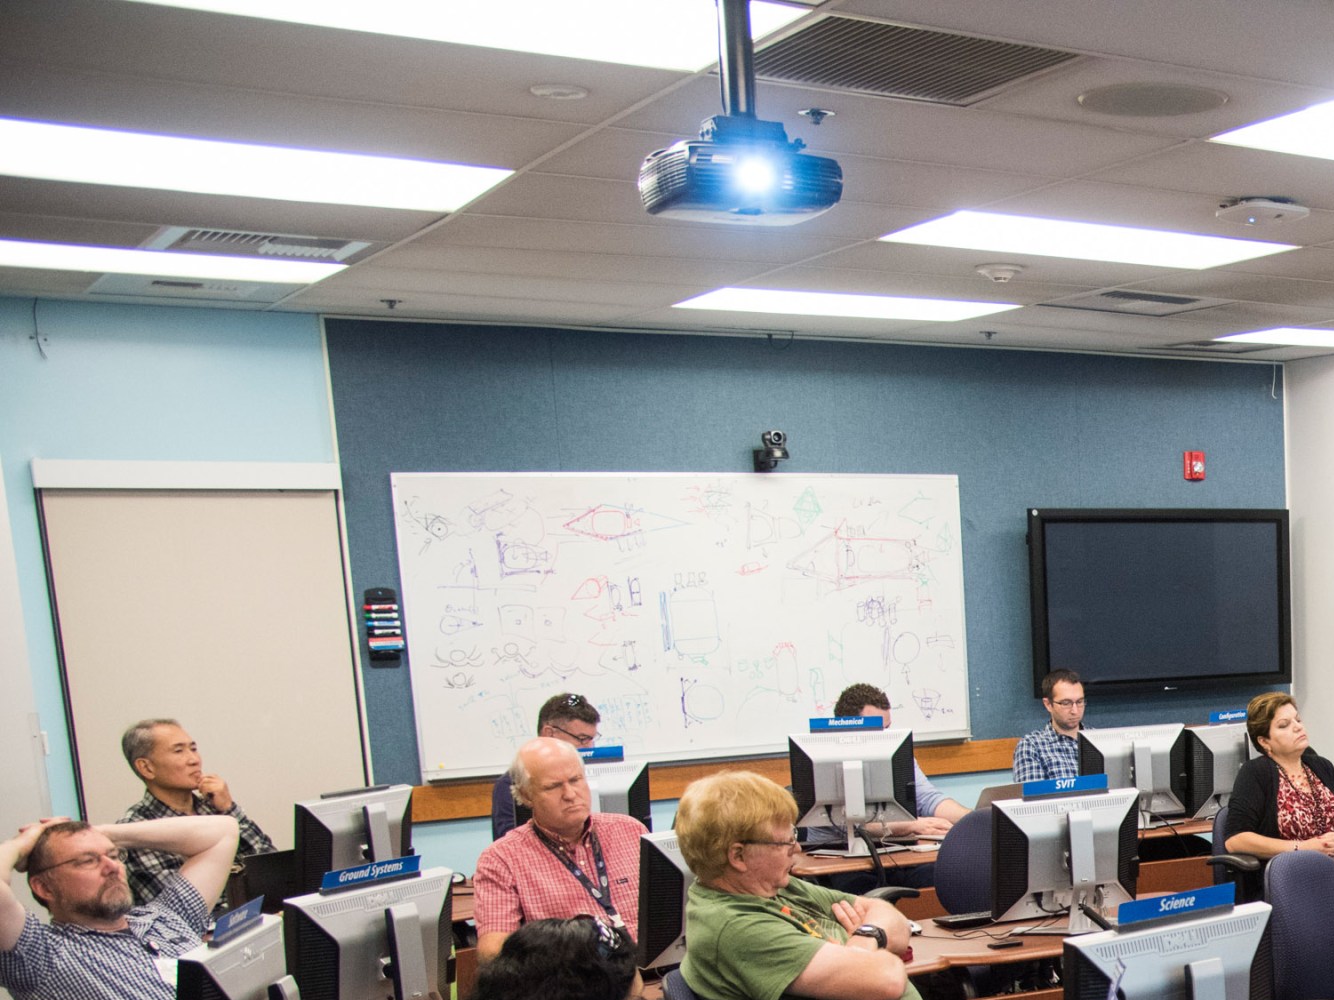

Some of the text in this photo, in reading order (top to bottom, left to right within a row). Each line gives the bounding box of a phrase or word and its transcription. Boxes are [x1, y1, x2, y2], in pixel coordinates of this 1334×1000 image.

[828, 717, 864, 726] Mechanical
[1055, 779, 1076, 790] SVIT
[339, 861, 404, 882] Ground Systems
[1159, 896, 1196, 912] Science
